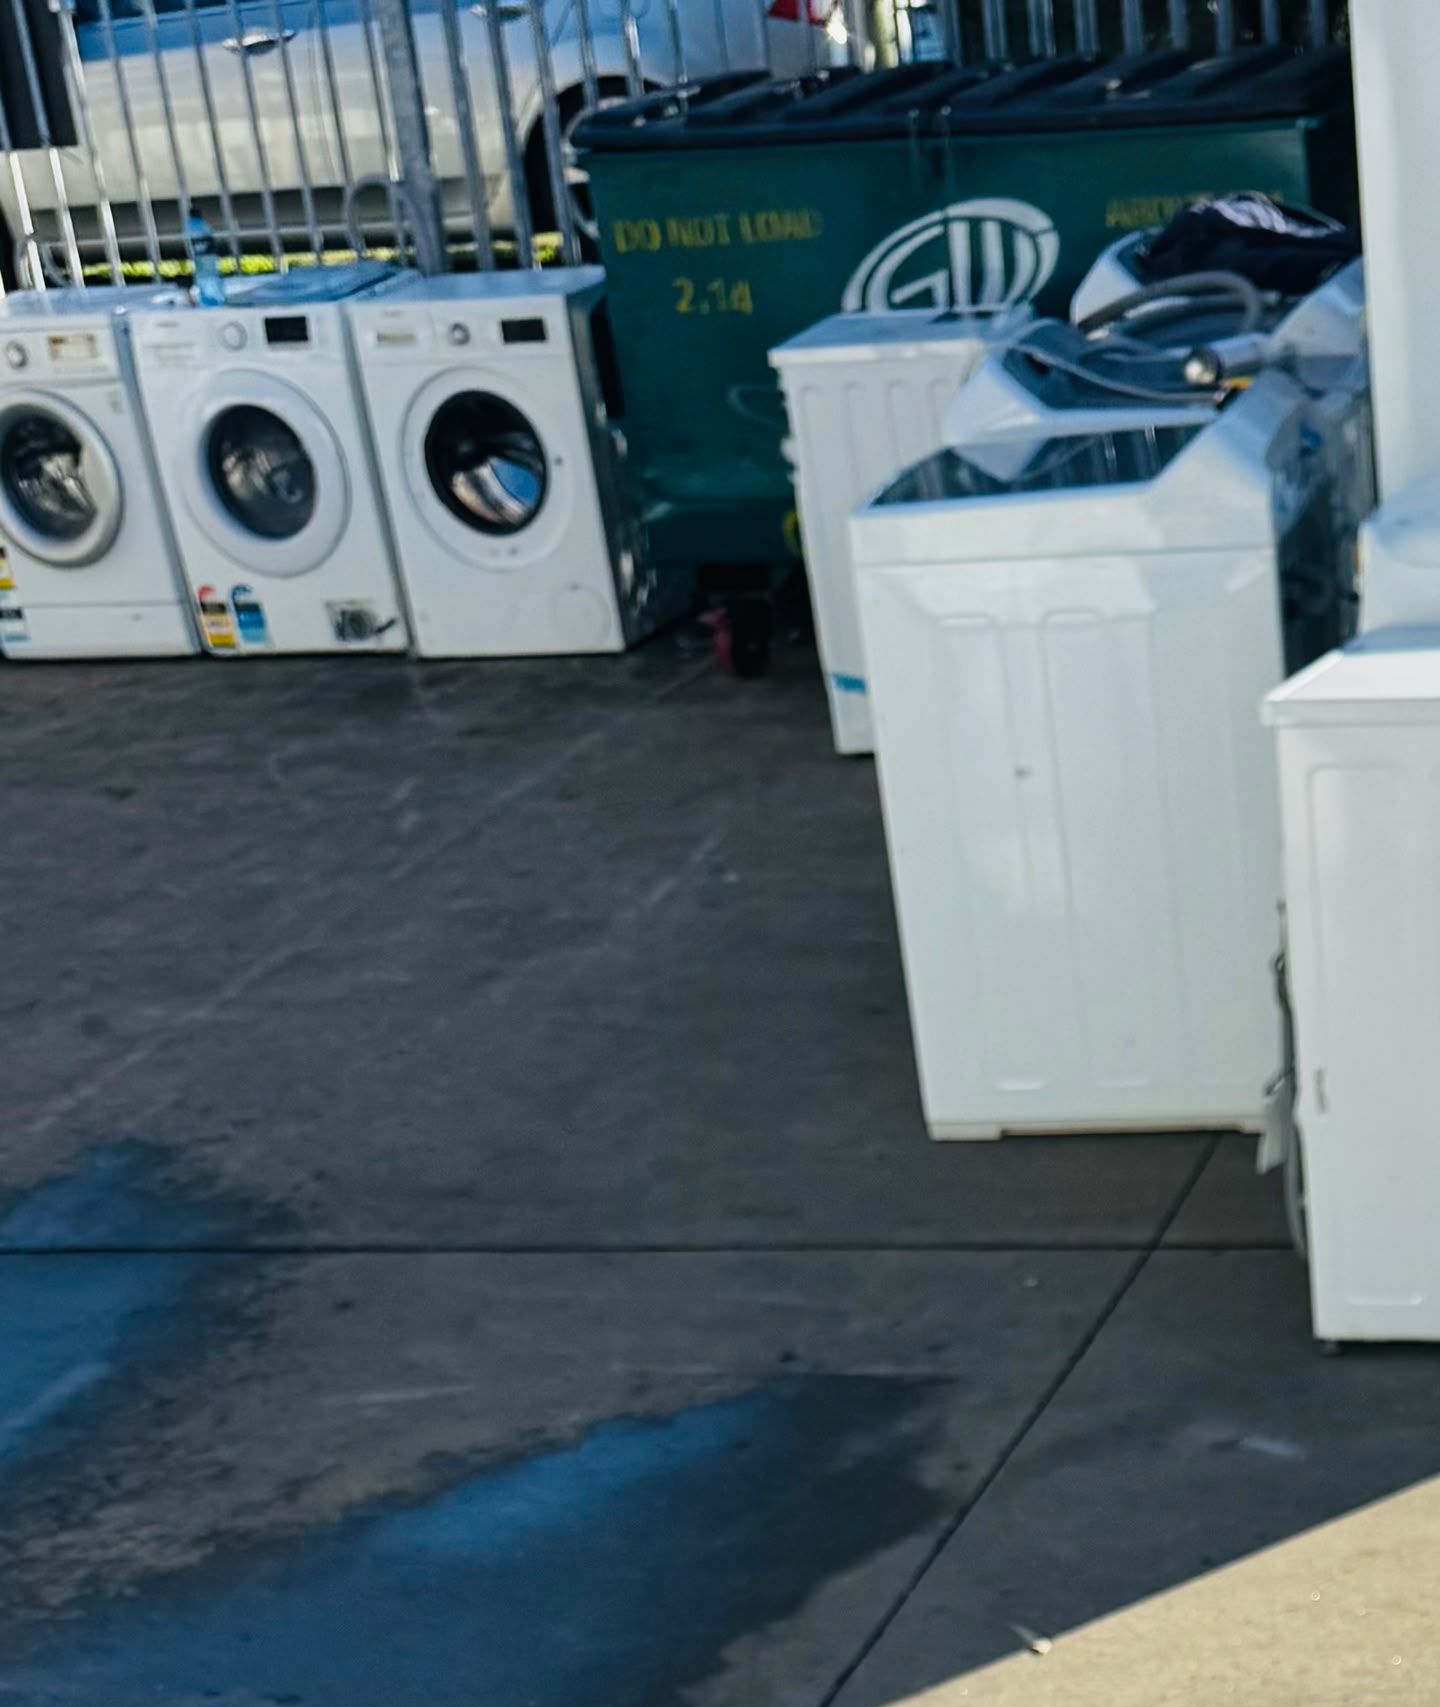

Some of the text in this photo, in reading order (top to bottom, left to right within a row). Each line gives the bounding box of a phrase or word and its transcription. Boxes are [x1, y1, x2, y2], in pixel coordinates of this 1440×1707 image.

[613, 218, 662, 253] DO
[666, 213, 731, 247] NOT
[671, 276, 753, 315] 2.14
